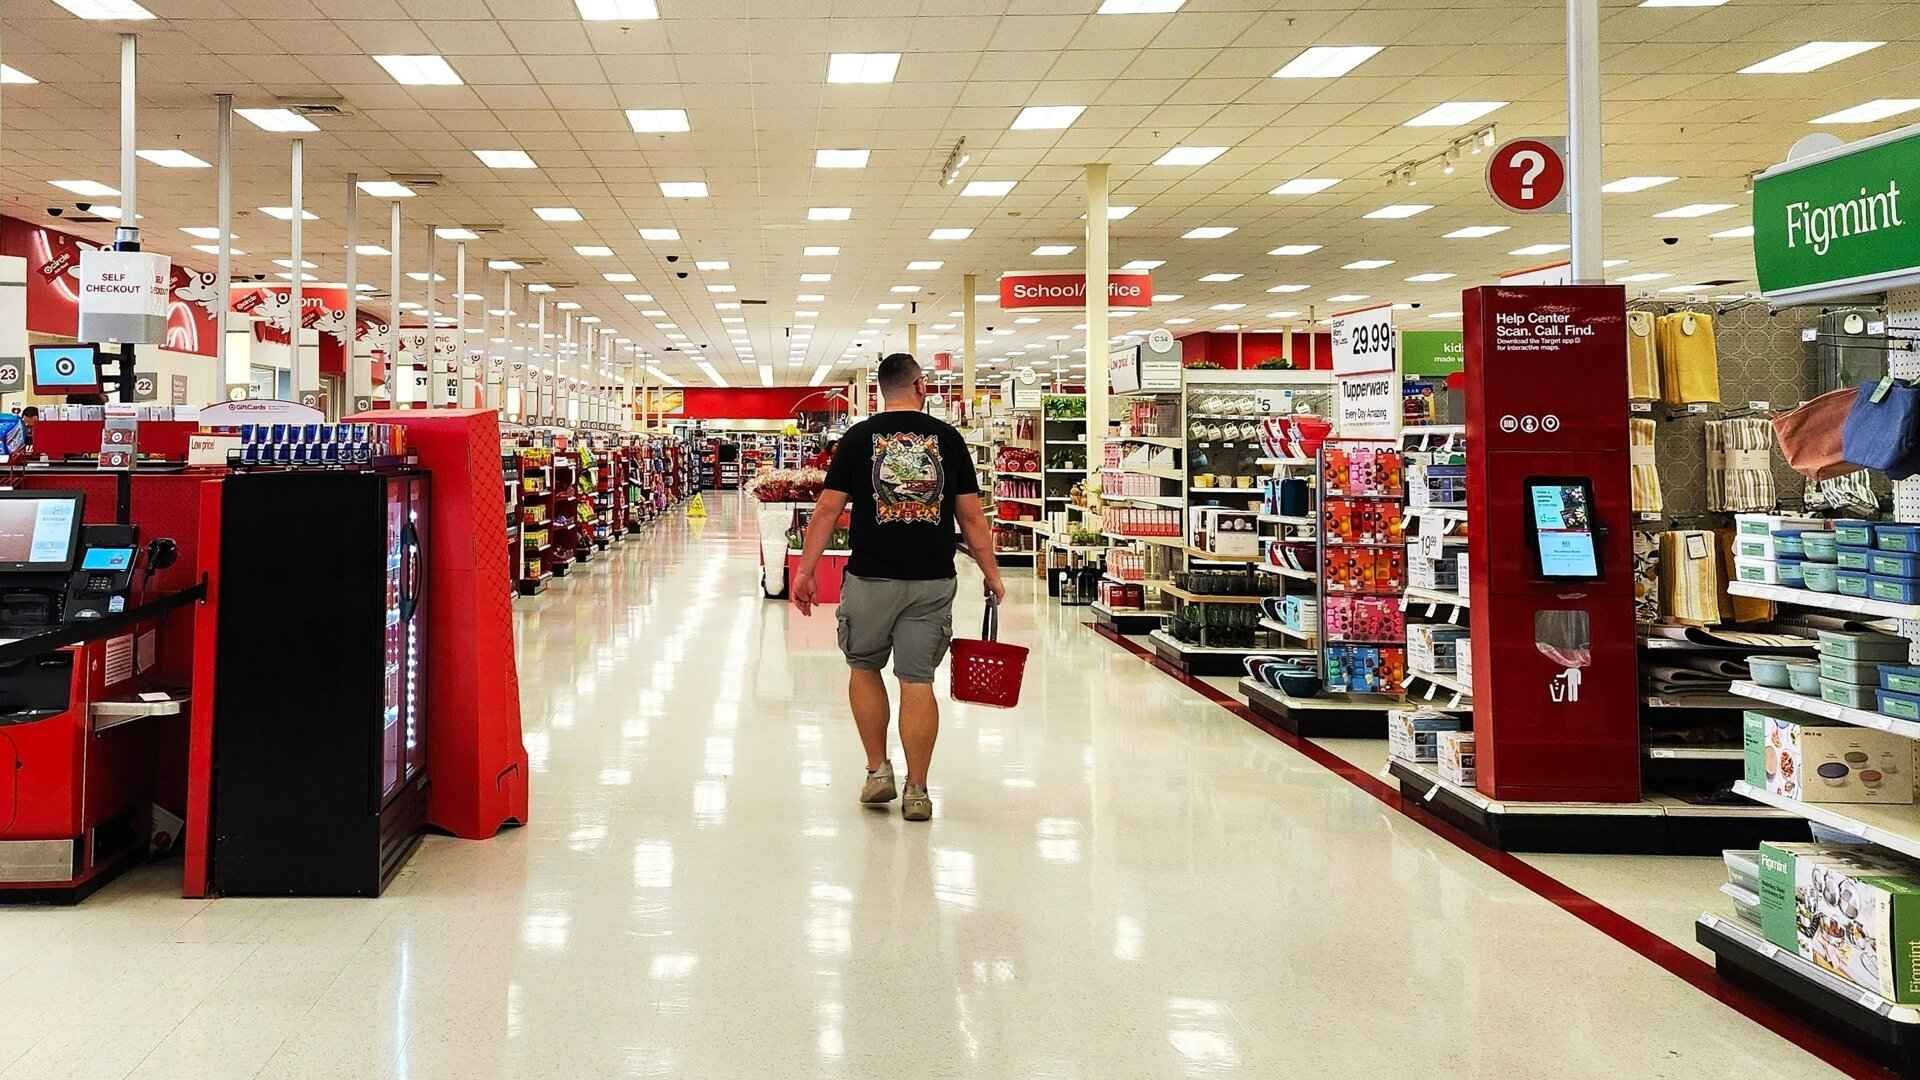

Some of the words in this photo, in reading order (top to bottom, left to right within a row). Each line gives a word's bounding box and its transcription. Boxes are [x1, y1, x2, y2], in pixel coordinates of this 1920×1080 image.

[1785, 180, 1904, 256] Figmint
[101, 273, 126, 282] SELF
[86, 284, 141, 294] CHECKOUT
[1496, 312, 1525, 326] Help
[1527, 312, 1570, 323] Center
[1496, 325, 1532, 337] Scan.
[1534, 325, 1562, 336] Call.
[1564, 324, 1595, 336] Find.
[1352, 322, 1390, 355] 29.99
[0, 369, 17, 380] 23
[138, 381, 151, 391] 22
[1342, 380, 1389, 401] Tupperware
[1345, 408, 1357, 421] Every
[1357, 408, 1366, 421] Day
[1367, 408, 1387, 420] Amazing
[191, 440, 202, 450] Low
